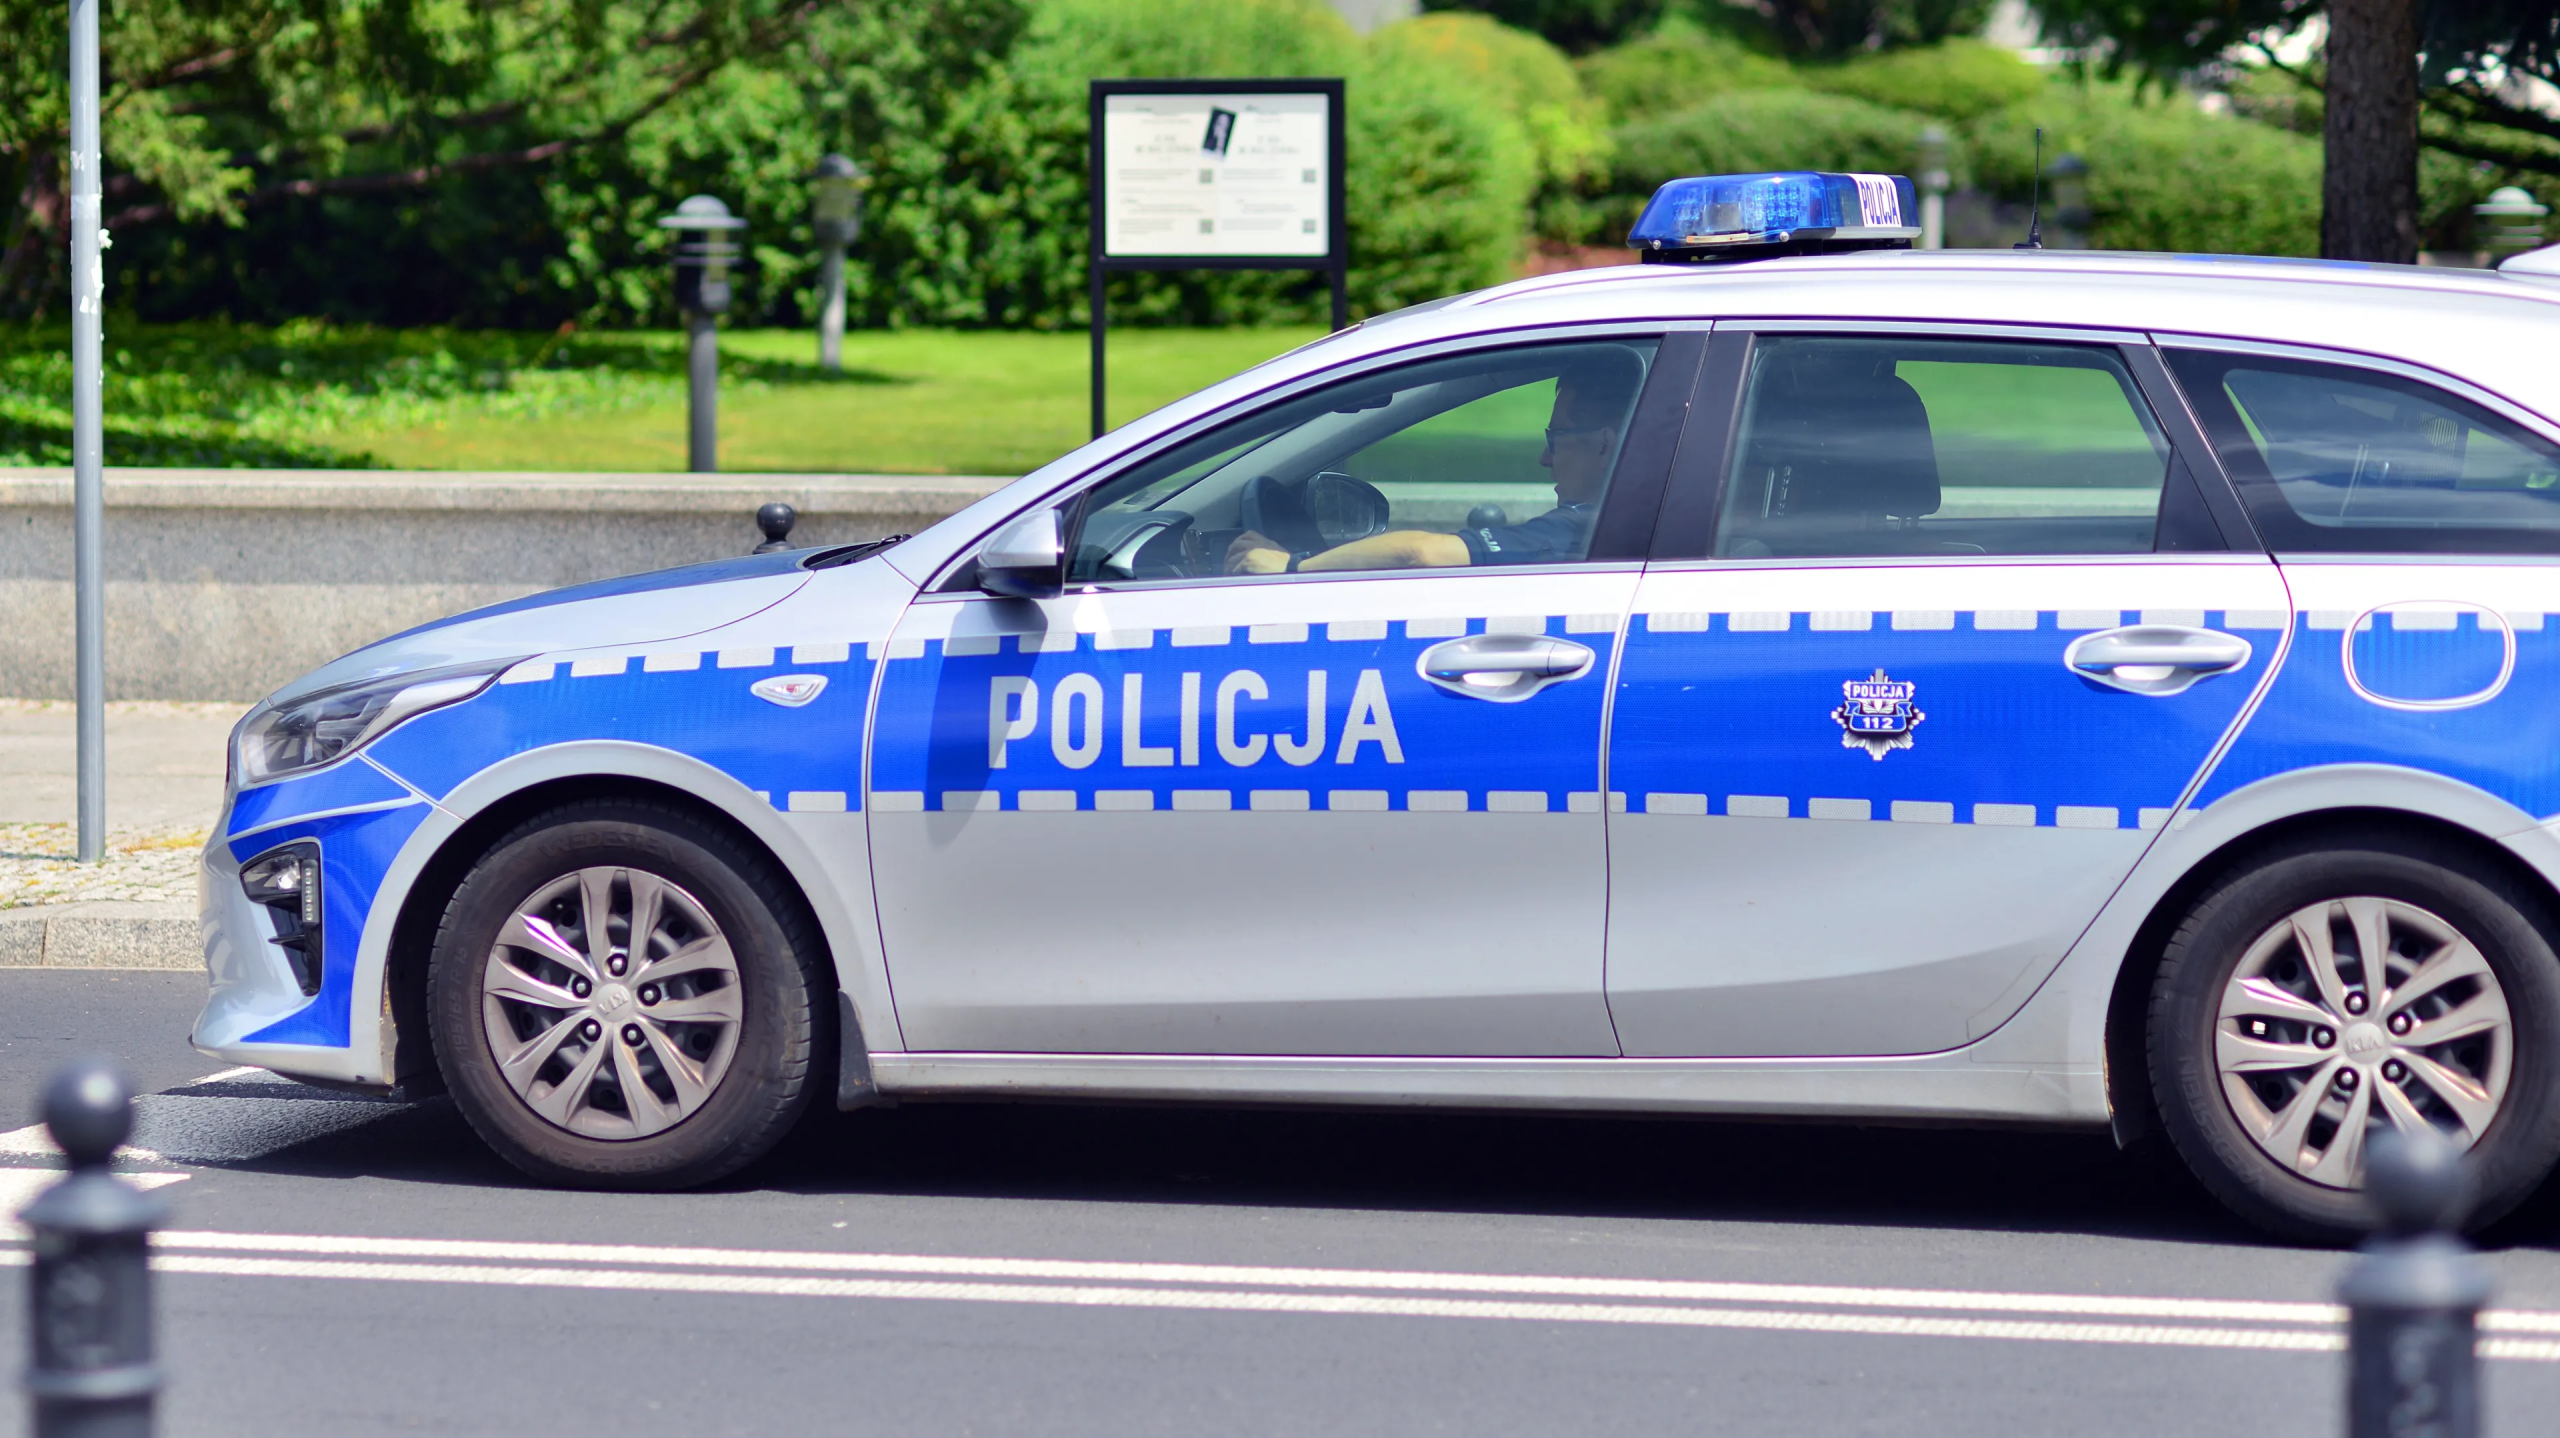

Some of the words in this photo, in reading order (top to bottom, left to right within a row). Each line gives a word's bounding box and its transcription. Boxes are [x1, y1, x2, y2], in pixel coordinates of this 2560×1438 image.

[1859, 181, 1899, 225] POLICJA
[1853, 685, 1904, 698] POLICJA
[989, 669, 1405, 770] POLICJA
[1863, 717, 1894, 729] 112
[598, 991, 628, 1015] KIA
[448, 990, 469, 1054] 195/65
[2346, 1038, 2382, 1054] KIA
